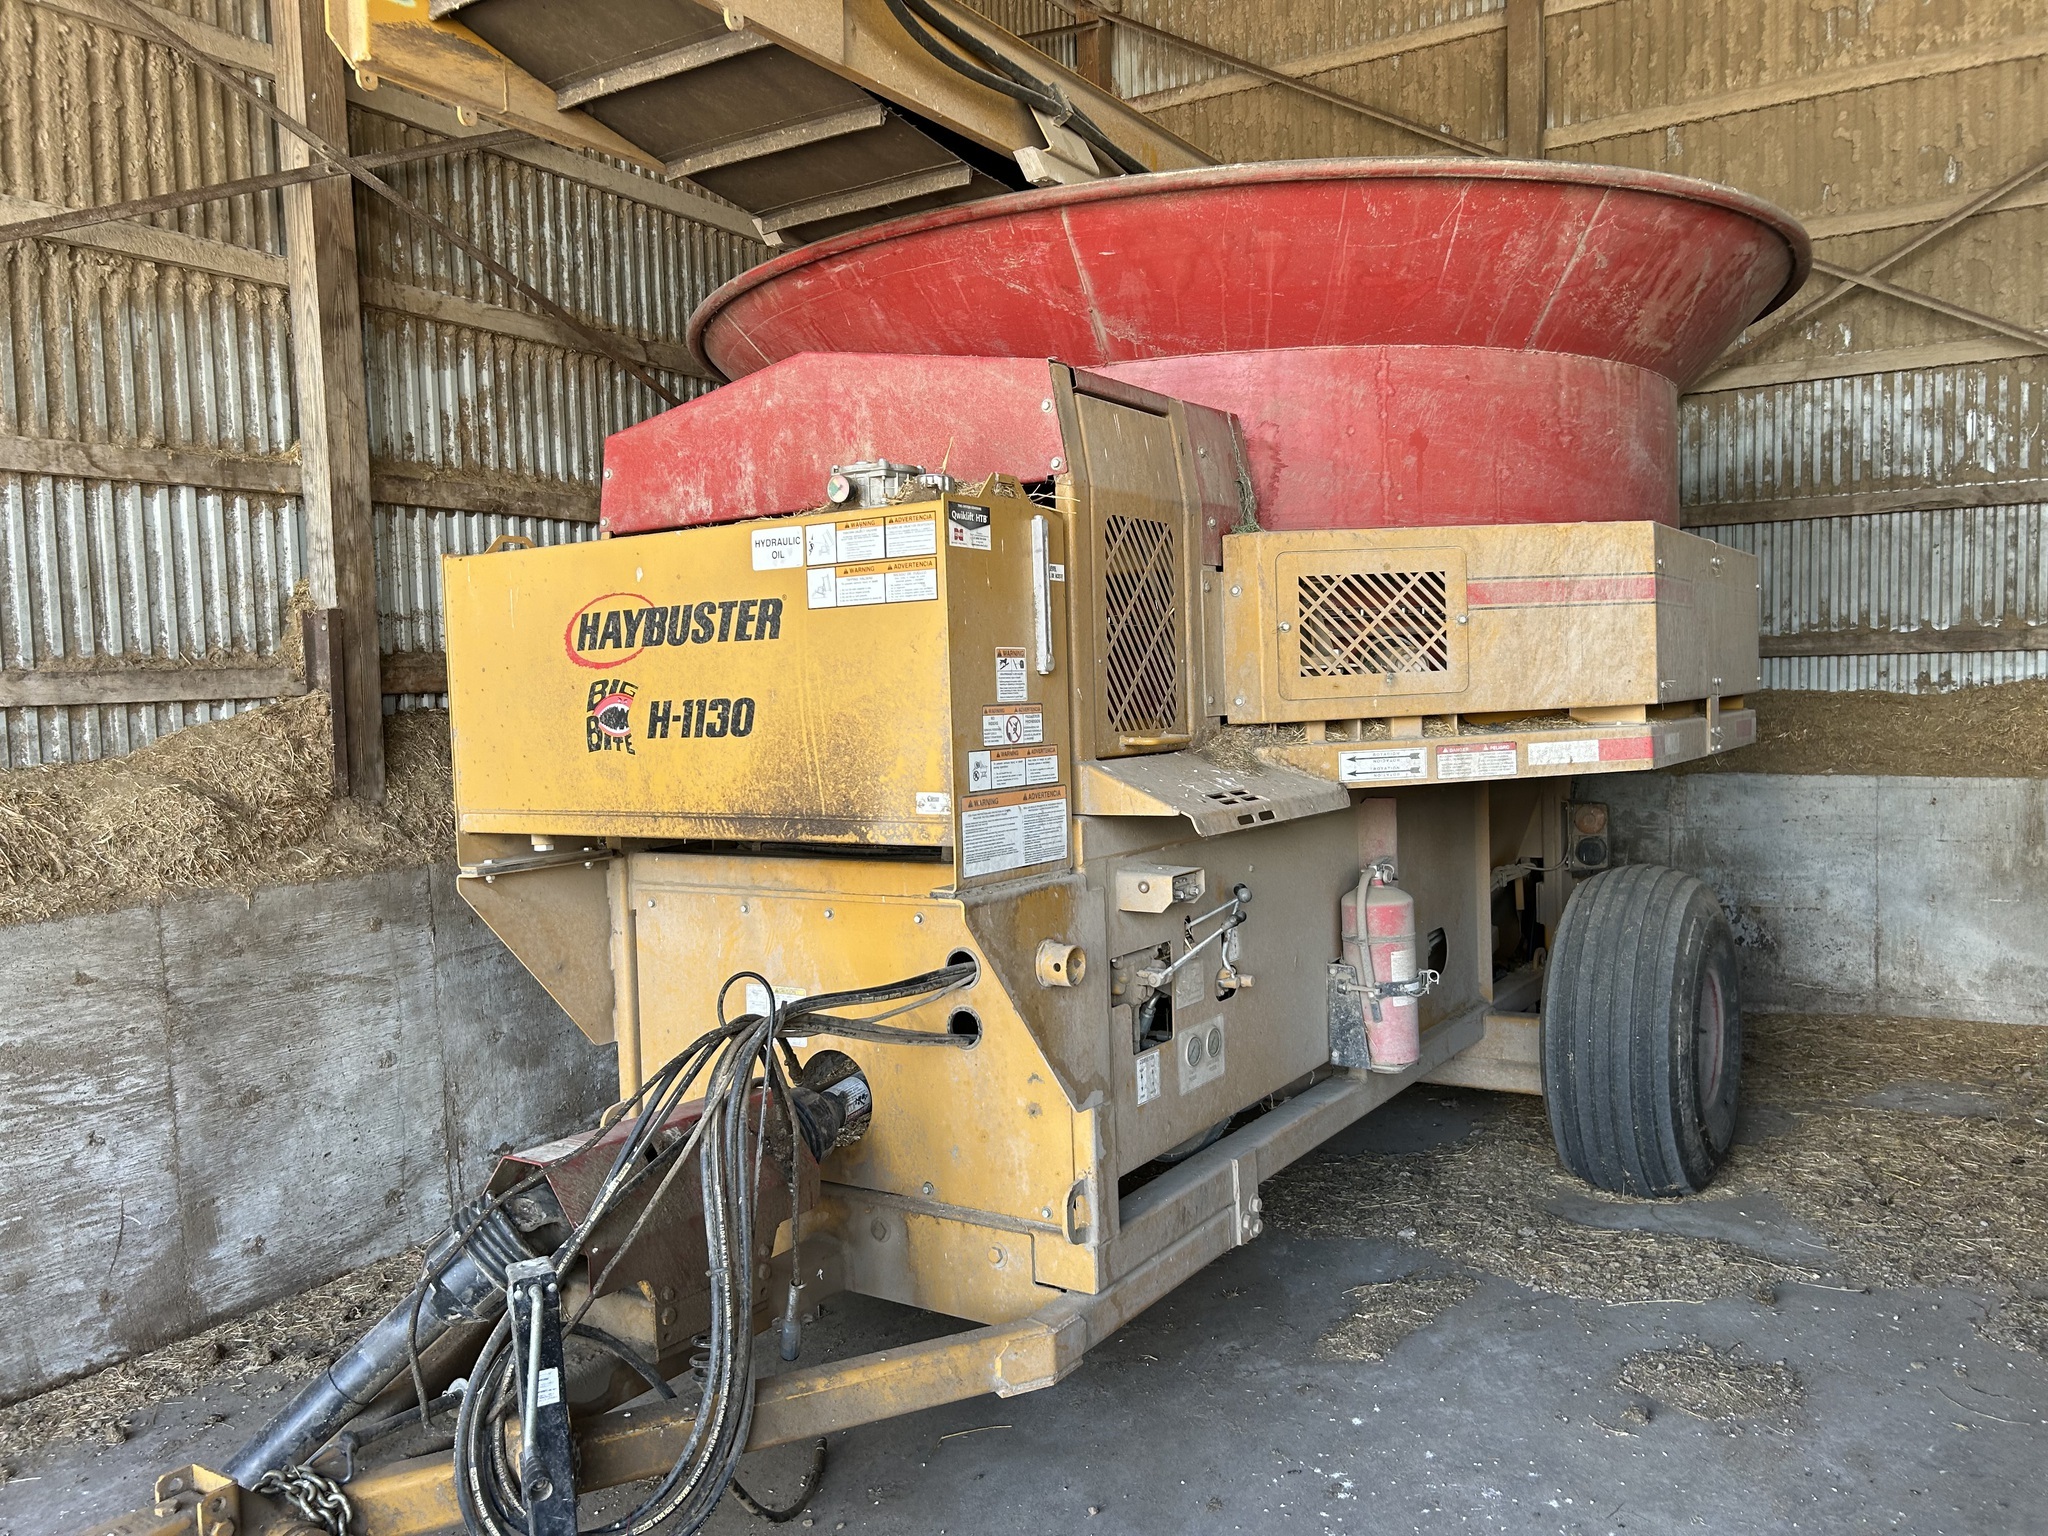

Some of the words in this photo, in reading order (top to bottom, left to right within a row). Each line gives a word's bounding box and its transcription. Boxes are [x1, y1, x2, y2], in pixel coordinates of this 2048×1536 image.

[894, 514, 932, 523] ADVERTENCIA
[952, 510, 974, 521] Qwiklift
[976, 514, 987, 523] HTB
[850, 520, 876, 528] WARNING
[755, 536, 800, 548] HYDRAULIC
[772, 550, 784, 559] OIL
[894, 560, 933, 570] ADVERTENCIA
[577, 598, 783, 651] HAYBUSTER
[586, 679, 638, 712] BIG
[648, 698, 756, 739] H-1130
[586, 715, 636, 756] BITE
[1028, 790, 1061, 800] ADVERTENCIA
[974, 798, 999, 807] WARNING
[652, 1504, 676, 1523] TOUGH
[674, 1485, 692, 1504] COVER
[703, 1452, 711, 1462] WP
[708, 1440, 716, 1452] 21.0
[712, 1426, 720, 1440] MPa
[475, 1491, 488, 1519] TOUGH
